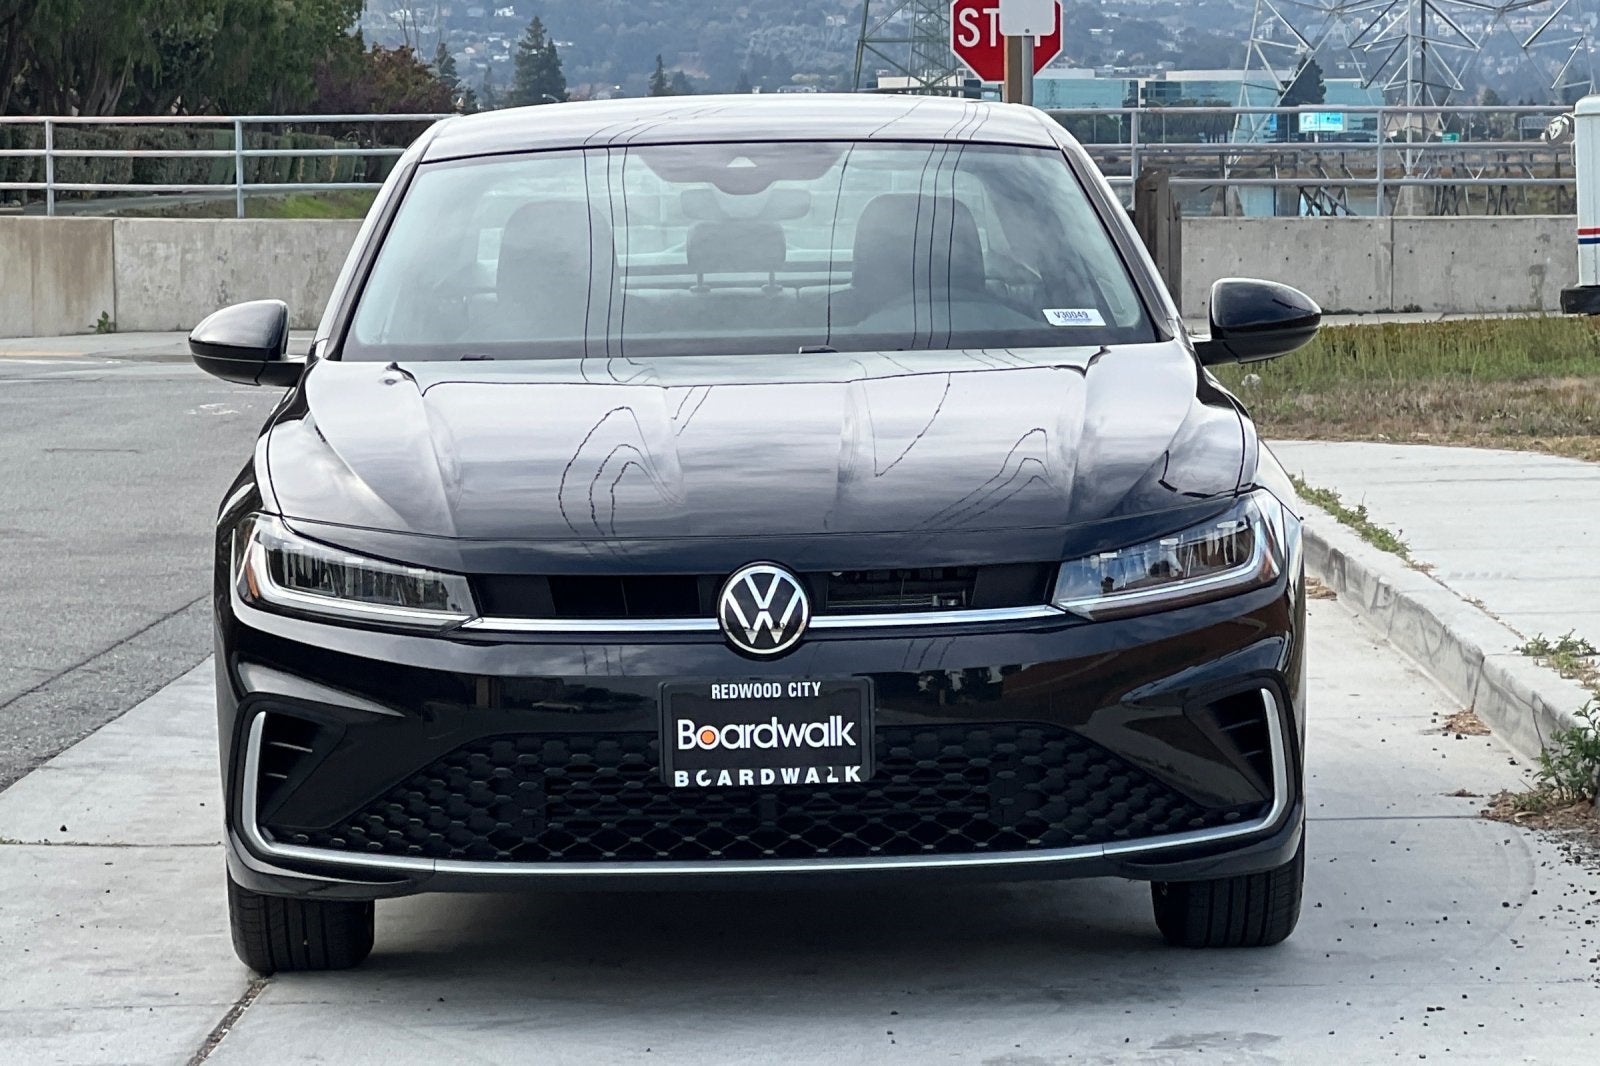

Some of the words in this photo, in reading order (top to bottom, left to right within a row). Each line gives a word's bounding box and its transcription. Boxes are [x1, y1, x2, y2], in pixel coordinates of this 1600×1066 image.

[958, 7, 1041, 47] ST
[724, 570, 803, 645] VW
[711, 682, 782, 699] REDWOOD
[788, 681, 822, 697] CITY
[677, 715, 857, 750] Boardwalk
